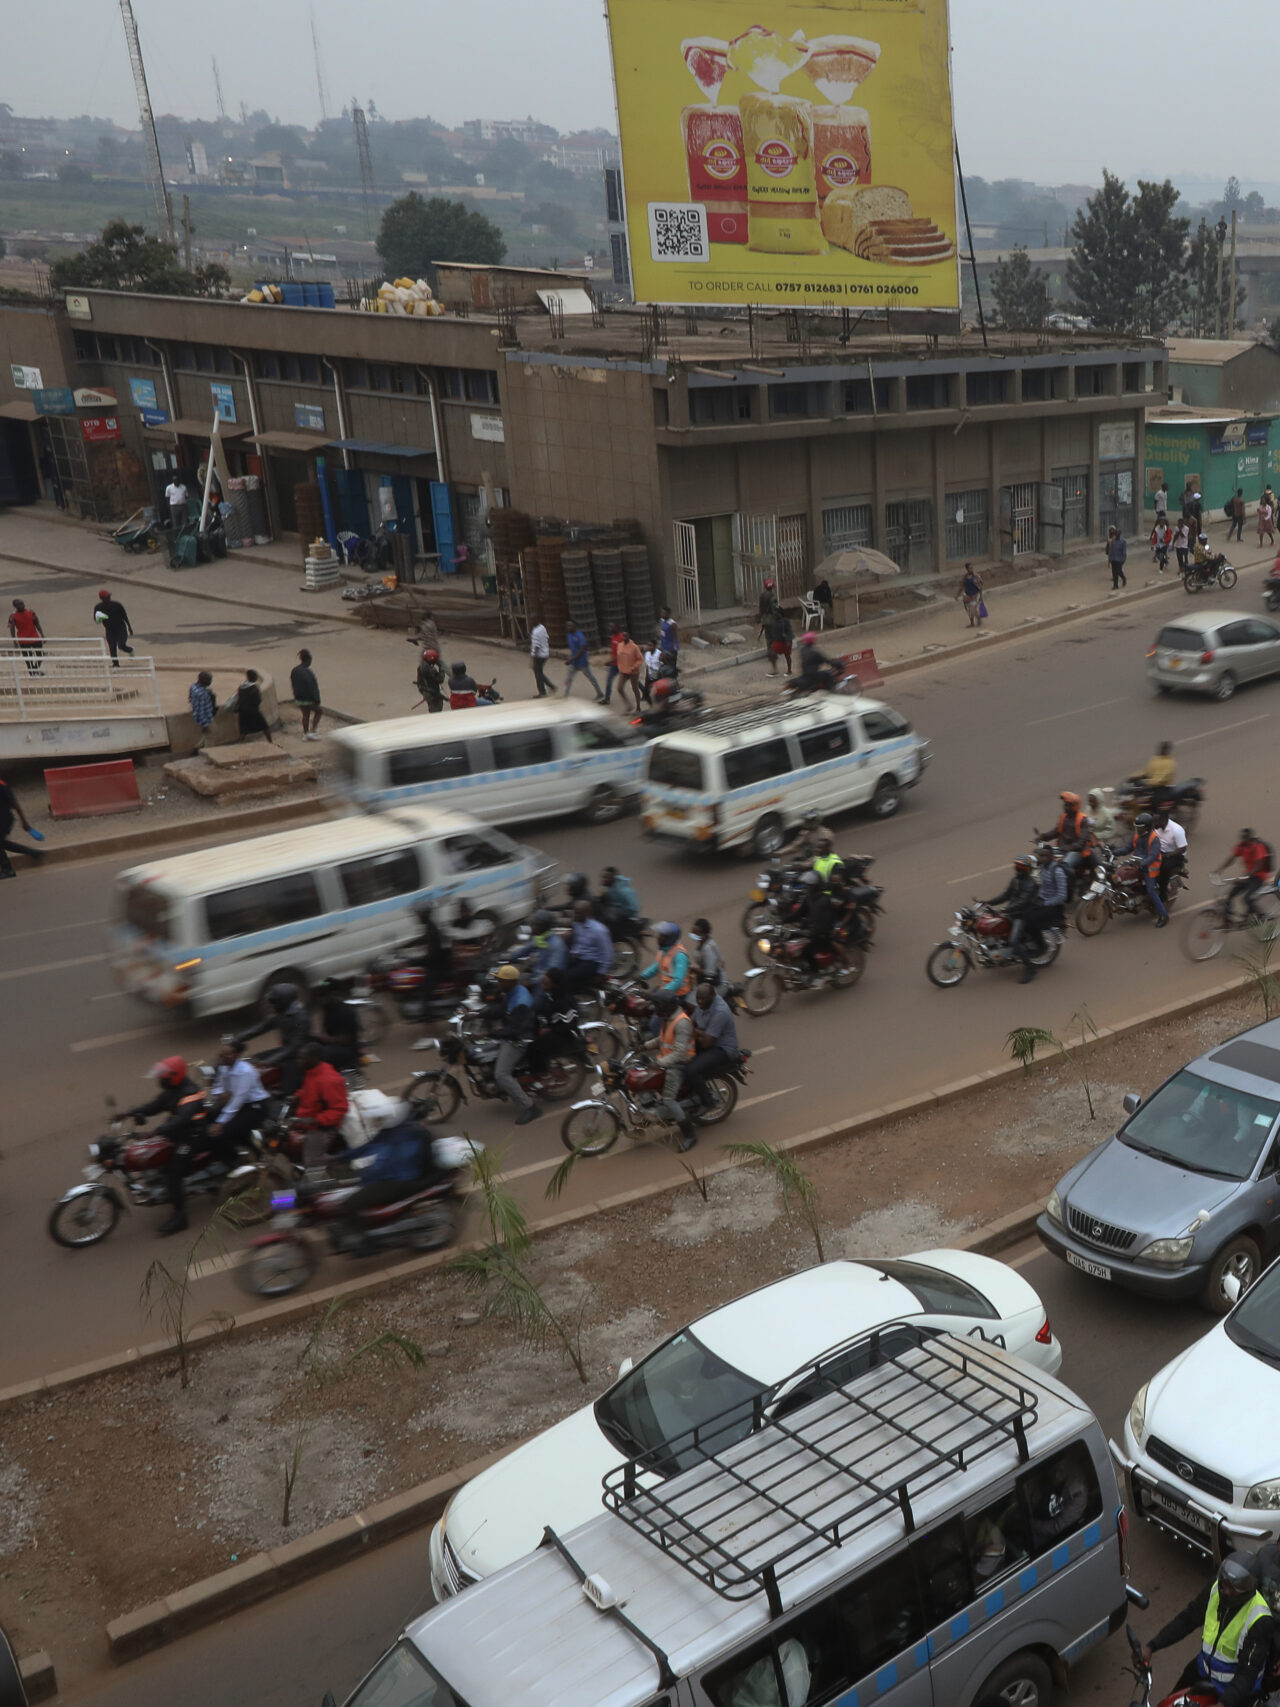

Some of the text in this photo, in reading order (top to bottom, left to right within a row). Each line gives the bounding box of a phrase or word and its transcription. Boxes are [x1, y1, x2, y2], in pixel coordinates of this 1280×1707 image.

[690, 281, 703, 291] TO
[706, 281, 744, 291] ORDER
[747, 282, 772, 292] CALL
[776, 282, 801, 292] 0757
[804, 283, 842, 293] 812683
[850, 284, 873, 293] 0761
[876, 285, 919, 295] 026000
[1146, 433, 1201, 451] Strength
[1144, 448, 1190, 465] Quality
[1073, 1256, 1106, 1278] UAS 075H
